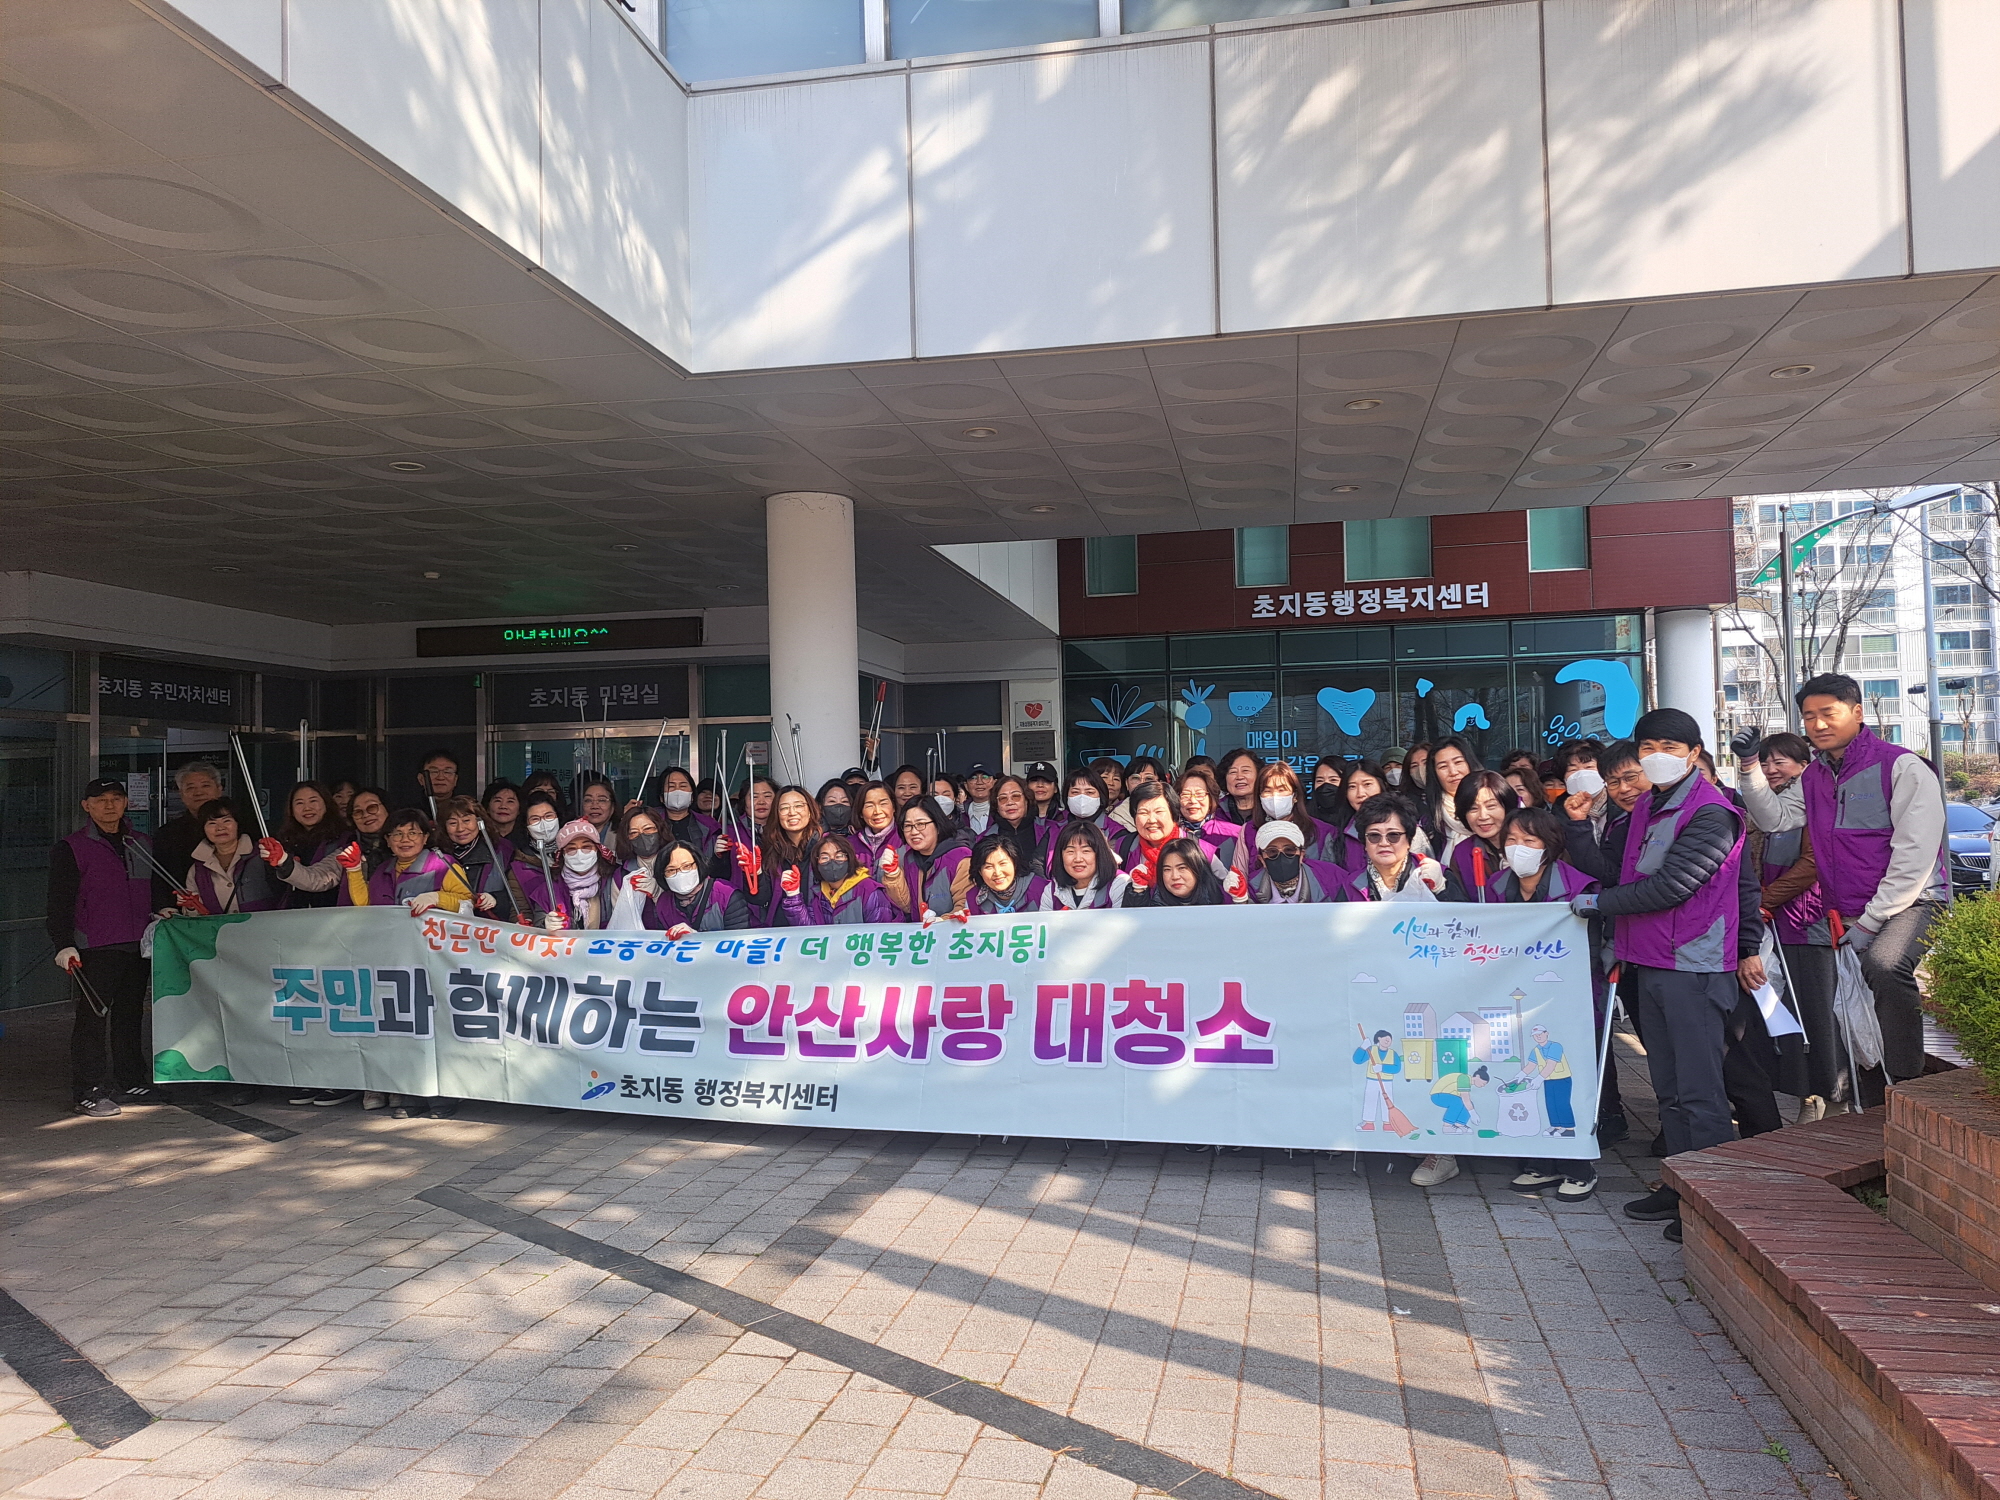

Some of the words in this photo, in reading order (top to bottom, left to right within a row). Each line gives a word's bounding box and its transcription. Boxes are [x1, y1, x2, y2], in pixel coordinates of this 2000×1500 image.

[1251, 581, 1490, 619] 초지동행정복지센터
[99, 676, 143, 698] 초지동
[149, 681, 231, 706] 주민자치센터
[528, 686, 589, 708] 초지동
[599, 683, 660, 706] 민원실
[1246, 730, 1297, 749] 매일이
[422, 917, 500, 954] 친근한
[715, 936, 787, 965] 마을!
[800, 936, 829, 960] 더
[845, 930, 936, 967] 행복한
[948, 924, 1047, 963] 초지동!
[1392, 916, 1443, 945] 시민과
[1409, 945, 1457, 968] 자유로운
[1463, 943, 1519, 966] 혁신도시
[1525, 939, 1571, 960] 안산
[271, 967, 434, 1035] 주민과
[448, 967, 702, 1054] 함께하는
[726, 981, 1013, 1062] 안산사랑
[1033, 980, 1275, 1064] 대청소
[619, 1074, 685, 1104] 초지동
[694, 1078, 839, 1113] 행정복지센터
